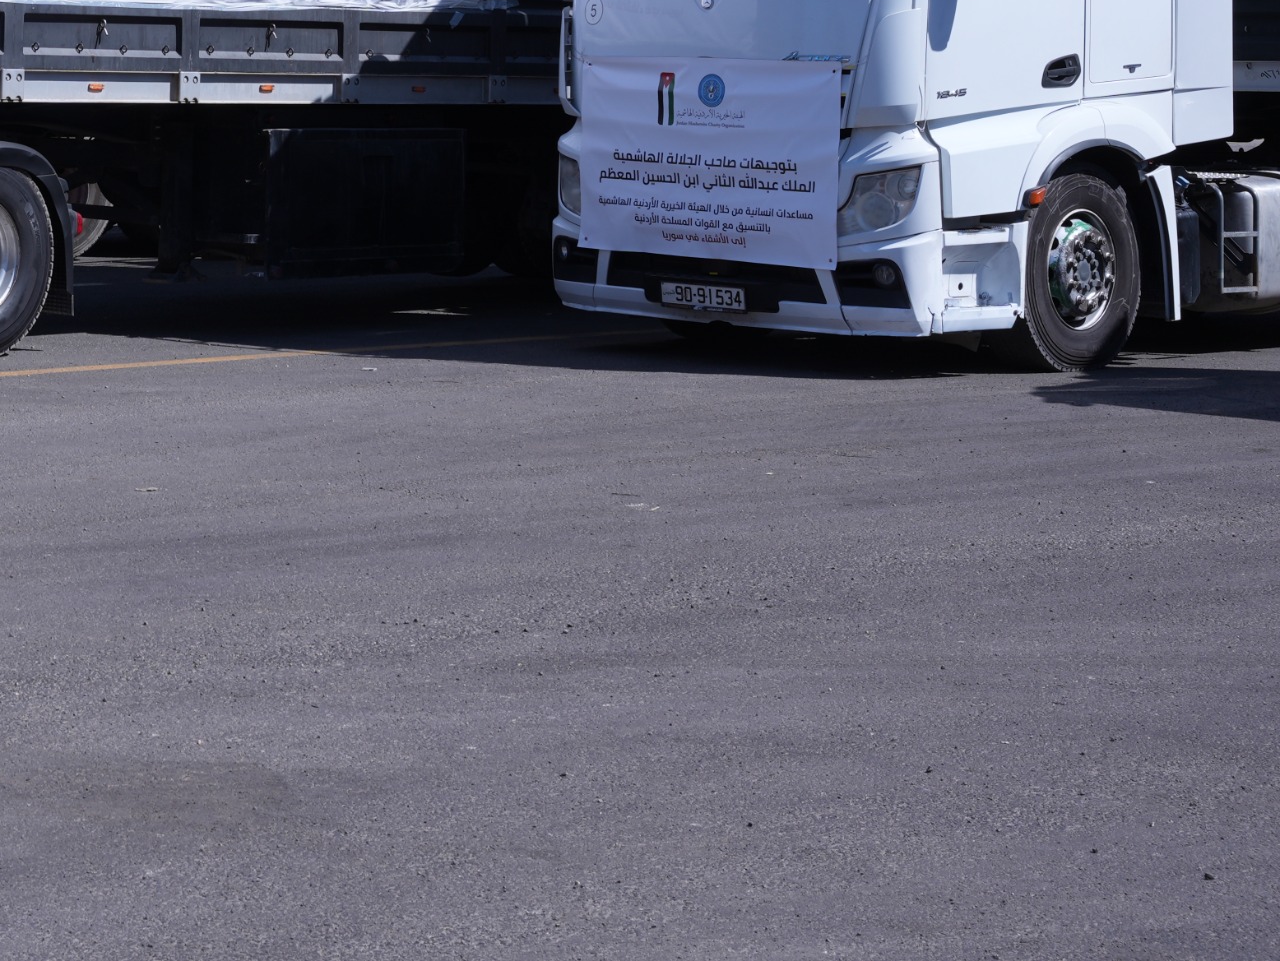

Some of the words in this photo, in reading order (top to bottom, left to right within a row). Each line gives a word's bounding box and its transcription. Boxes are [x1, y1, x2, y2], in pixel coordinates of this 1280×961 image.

[590, 4, 597, 18] 5
[613, 148, 663, 164] الهاشمية
[666, 152, 701, 168] الجلالة
[704, 155, 736, 170] صاحب
[740, 157, 797, 175] بتوجيهات
[599, 168, 640, 183] المعظم
[643, 170, 680, 185] الحسين
[683, 173, 699, 189] ابن
[702, 174, 735, 193] الثاني
[738, 173, 778, 194] عبدالله
[782, 178, 815, 193] الملك
[598, 196, 632, 207] الهاشمية
[633, 197, 658, 211] الأردنية
[660, 199, 686, 213] الخيرية
[688, 201, 711, 214] الهيئة
[713, 204, 730, 216] خلال
[731, 207, 744, 216] من
[745, 206, 774, 218] انسانية
[776, 208, 813, 220] مساعدات
[634, 212, 659, 226] الأردنية
[661, 215, 693, 227] المسلحة
[695, 217, 720, 231] القوات
[722, 221, 734, 232] مع
[736, 220, 771, 234] بالتنسيق
[662, 230, 684, 242] سوريا
[686, 233, 699, 243] في
[702, 232, 729, 245] الأشقاء
[732, 236, 746, 248] إلى
